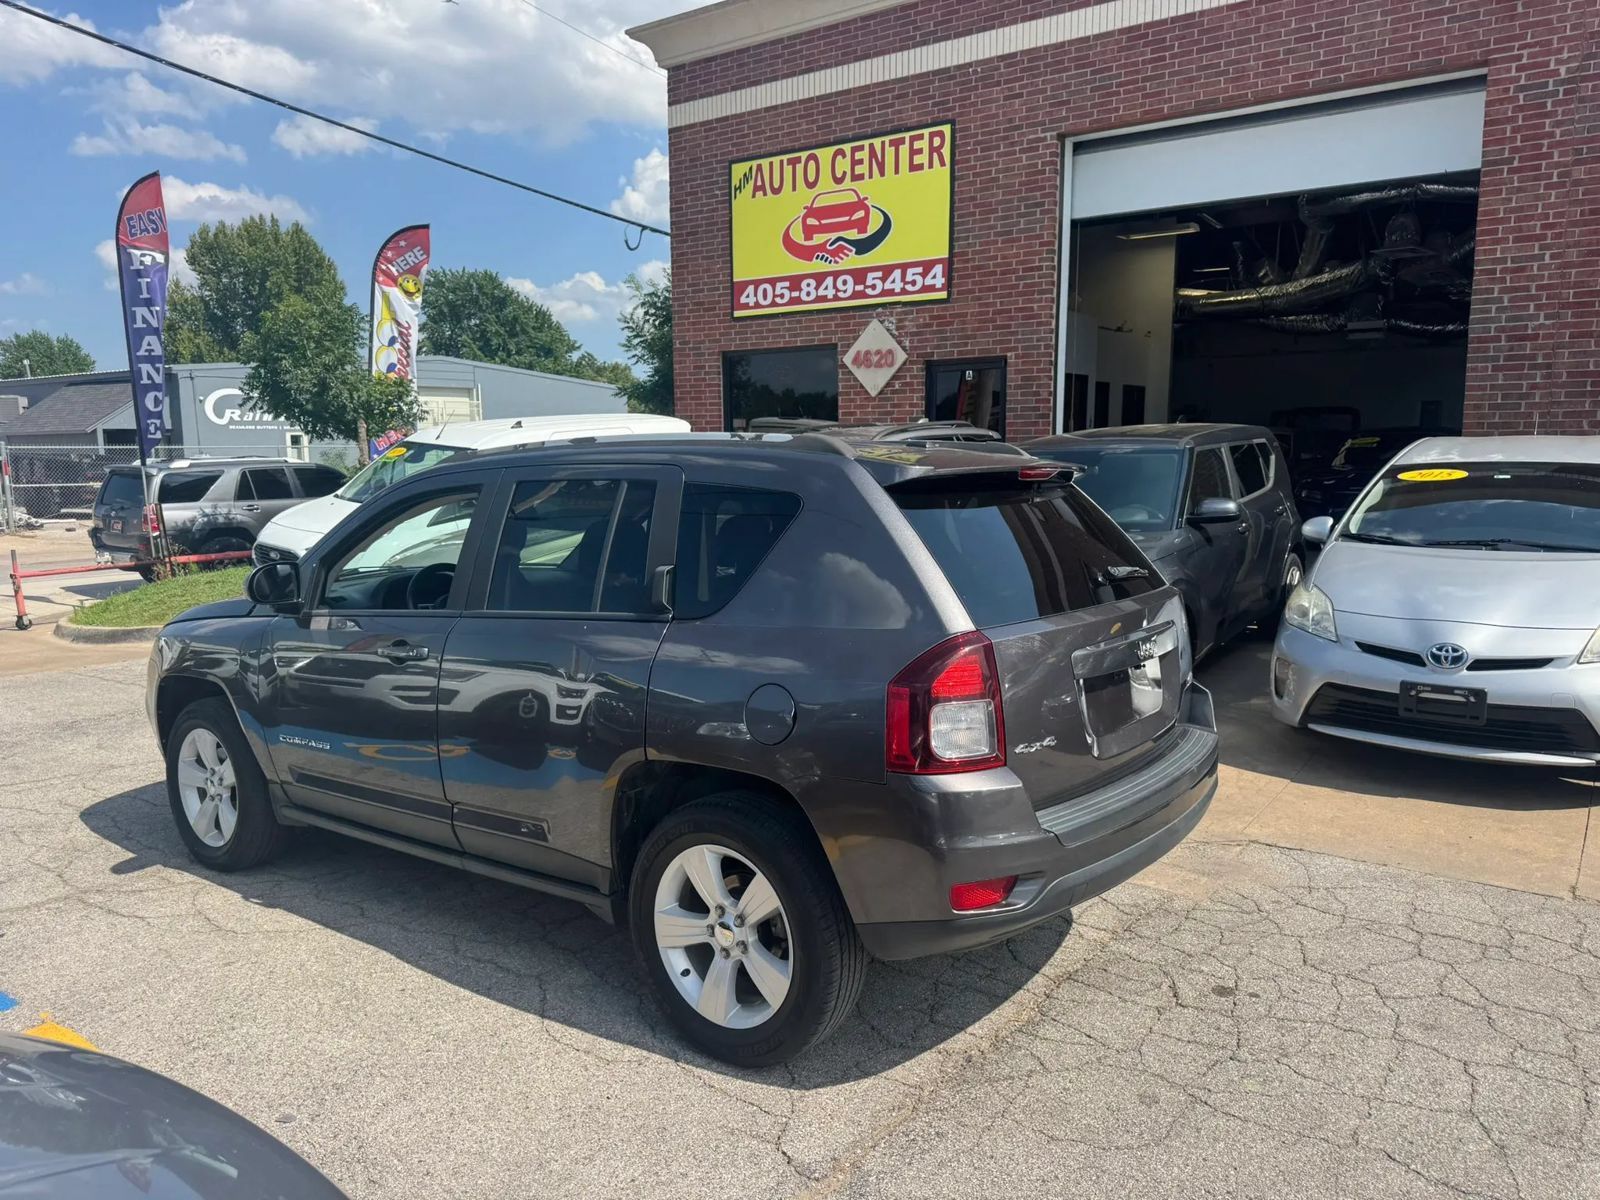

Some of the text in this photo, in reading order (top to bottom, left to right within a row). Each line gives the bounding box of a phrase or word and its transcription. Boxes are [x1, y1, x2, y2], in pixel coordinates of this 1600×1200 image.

[751, 129, 947, 199] AUTO CENTER
[733, 165, 753, 200] HM
[125, 207, 167, 239] EASY
[390, 246, 427, 275] HERE
[740, 263, 945, 306] 405-849-5454
[126, 248, 166, 440] FINANCE
[394, 320, 412, 380] pecial
[851, 349, 896, 370] 4620
[279, 734, 331, 750] COMPASS
